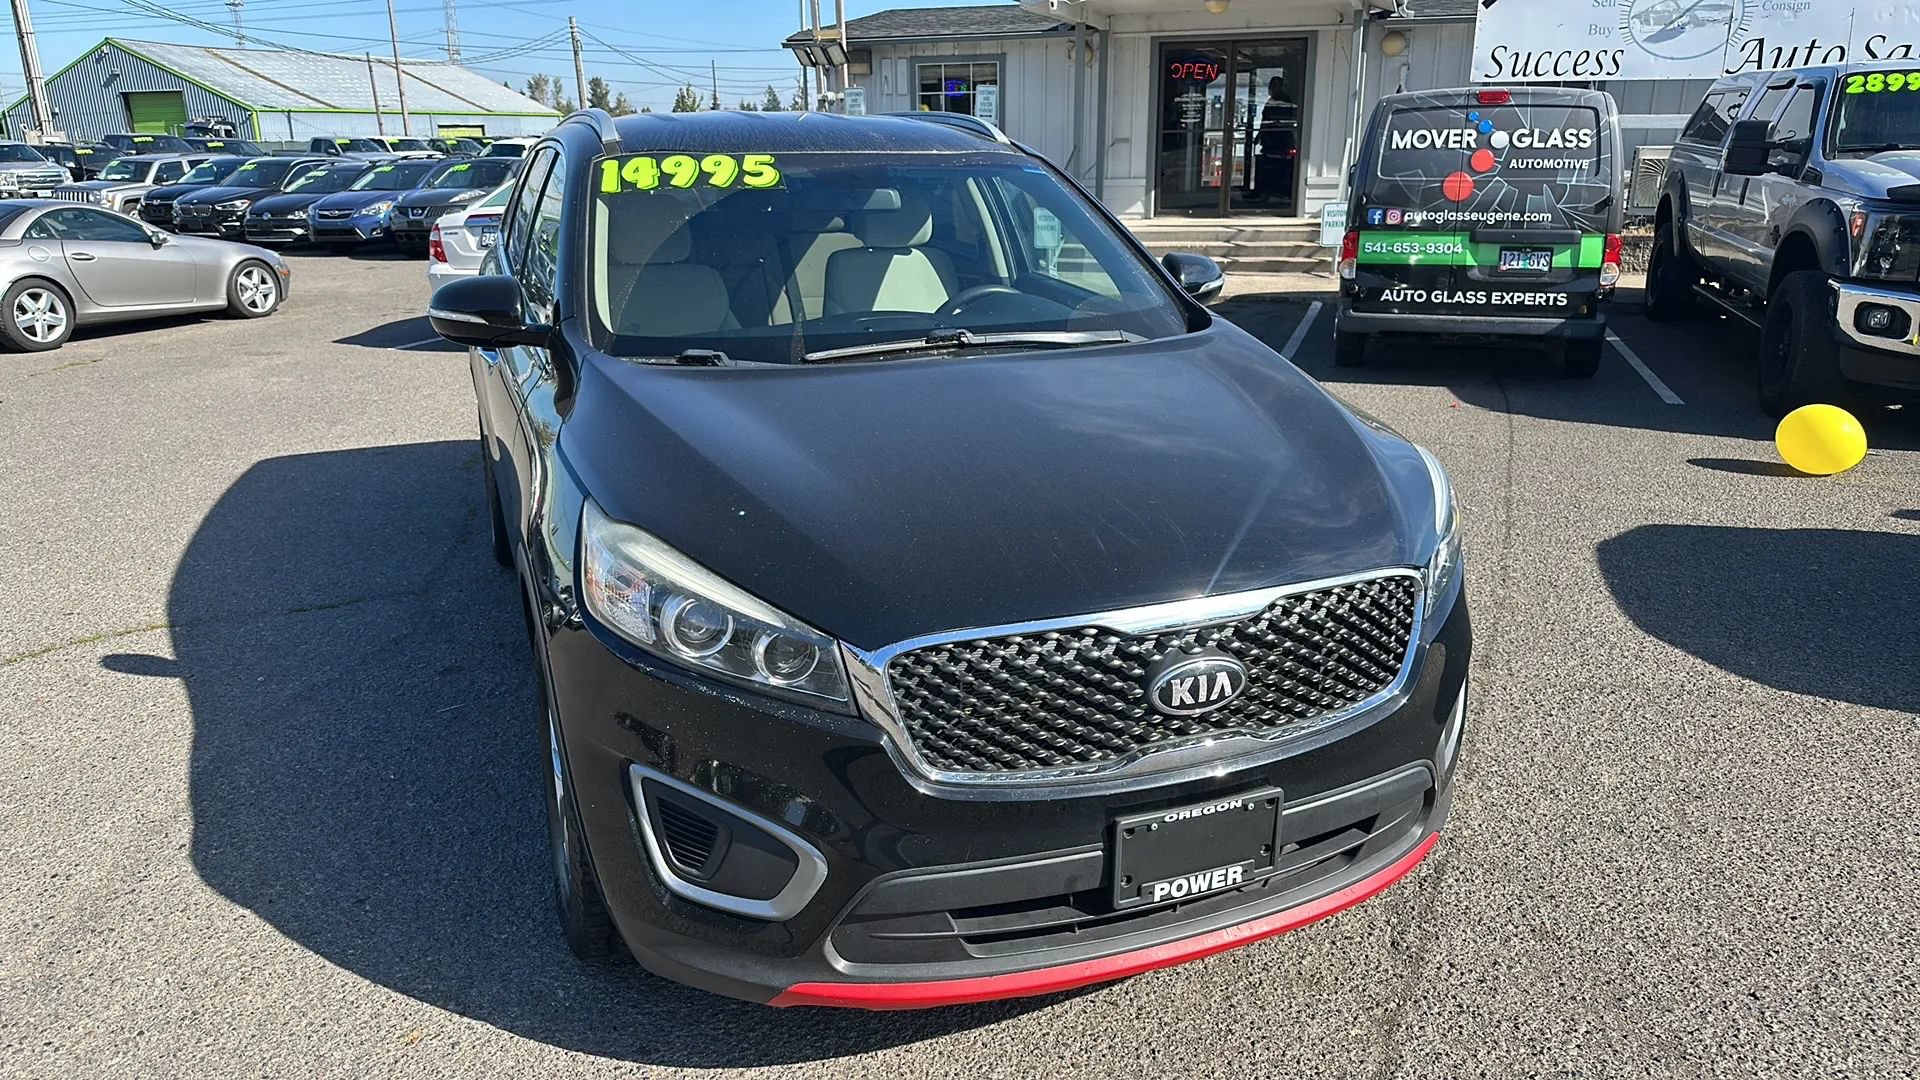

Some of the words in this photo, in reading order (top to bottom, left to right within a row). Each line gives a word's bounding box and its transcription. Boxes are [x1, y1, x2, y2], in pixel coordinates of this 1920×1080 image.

[1762, 0, 1811, 11] Consign
[1588, 23, 1614, 39] Buy
[1484, 45, 1624, 79] Success
[1725, 37, 1846, 75] Auto
[1865, 34, 1920, 60] Sa
[1171, 63, 1218, 80] OPEN
[1391, 129, 1478, 149] MOVER
[1512, 128, 1592, 148] GLASS
[1509, 158, 1590, 169] AUTOMOTIVE
[600, 154, 780, 193] 14995
[1325, 220, 1345, 228] PARKIN
[1403, 209, 1552, 225] autoglasseugene.com
[1364, 242, 1463, 255] 541-653-9304
[1503, 252, 1520, 267] 121
[1529, 253, 1550, 267] GVS
[1380, 289, 1427, 303] AUTO
[1431, 291, 1487, 304] GLASS
[1491, 292, 1568, 306] EXPERTS
[1171, 671, 1233, 707] KIA
[1163, 799, 1243, 823] OREGON
[1153, 865, 1243, 903] POWER
